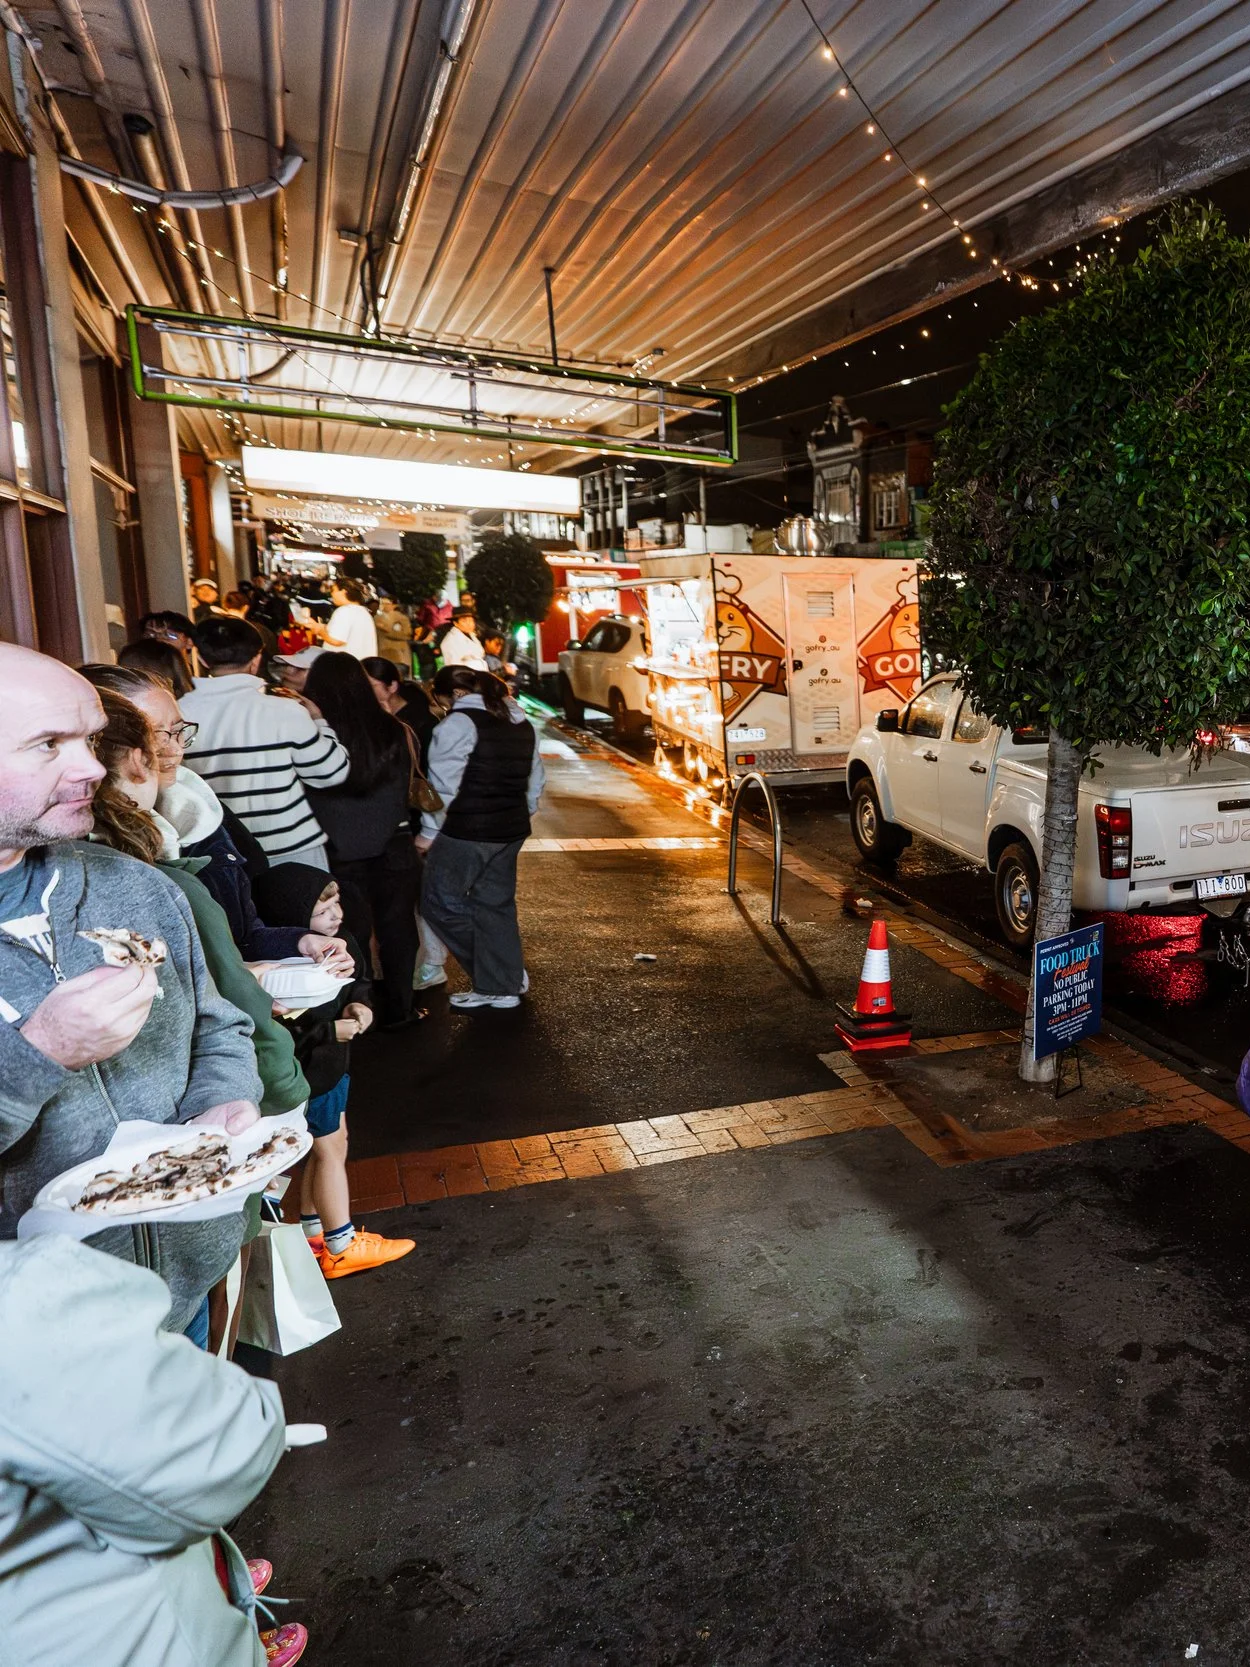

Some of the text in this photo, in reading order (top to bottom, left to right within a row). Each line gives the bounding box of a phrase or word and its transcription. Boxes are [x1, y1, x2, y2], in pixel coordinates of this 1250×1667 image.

[1040, 941, 1100, 975] FOOD TRUCK
[1043, 978, 1095, 1008] PARKING TODAY
[1054, 970, 1088, 991] NO PUBLIC
[1052, 1002, 1067, 1016] 3PM
[1072, 994, 1088, 1010] 11PM
